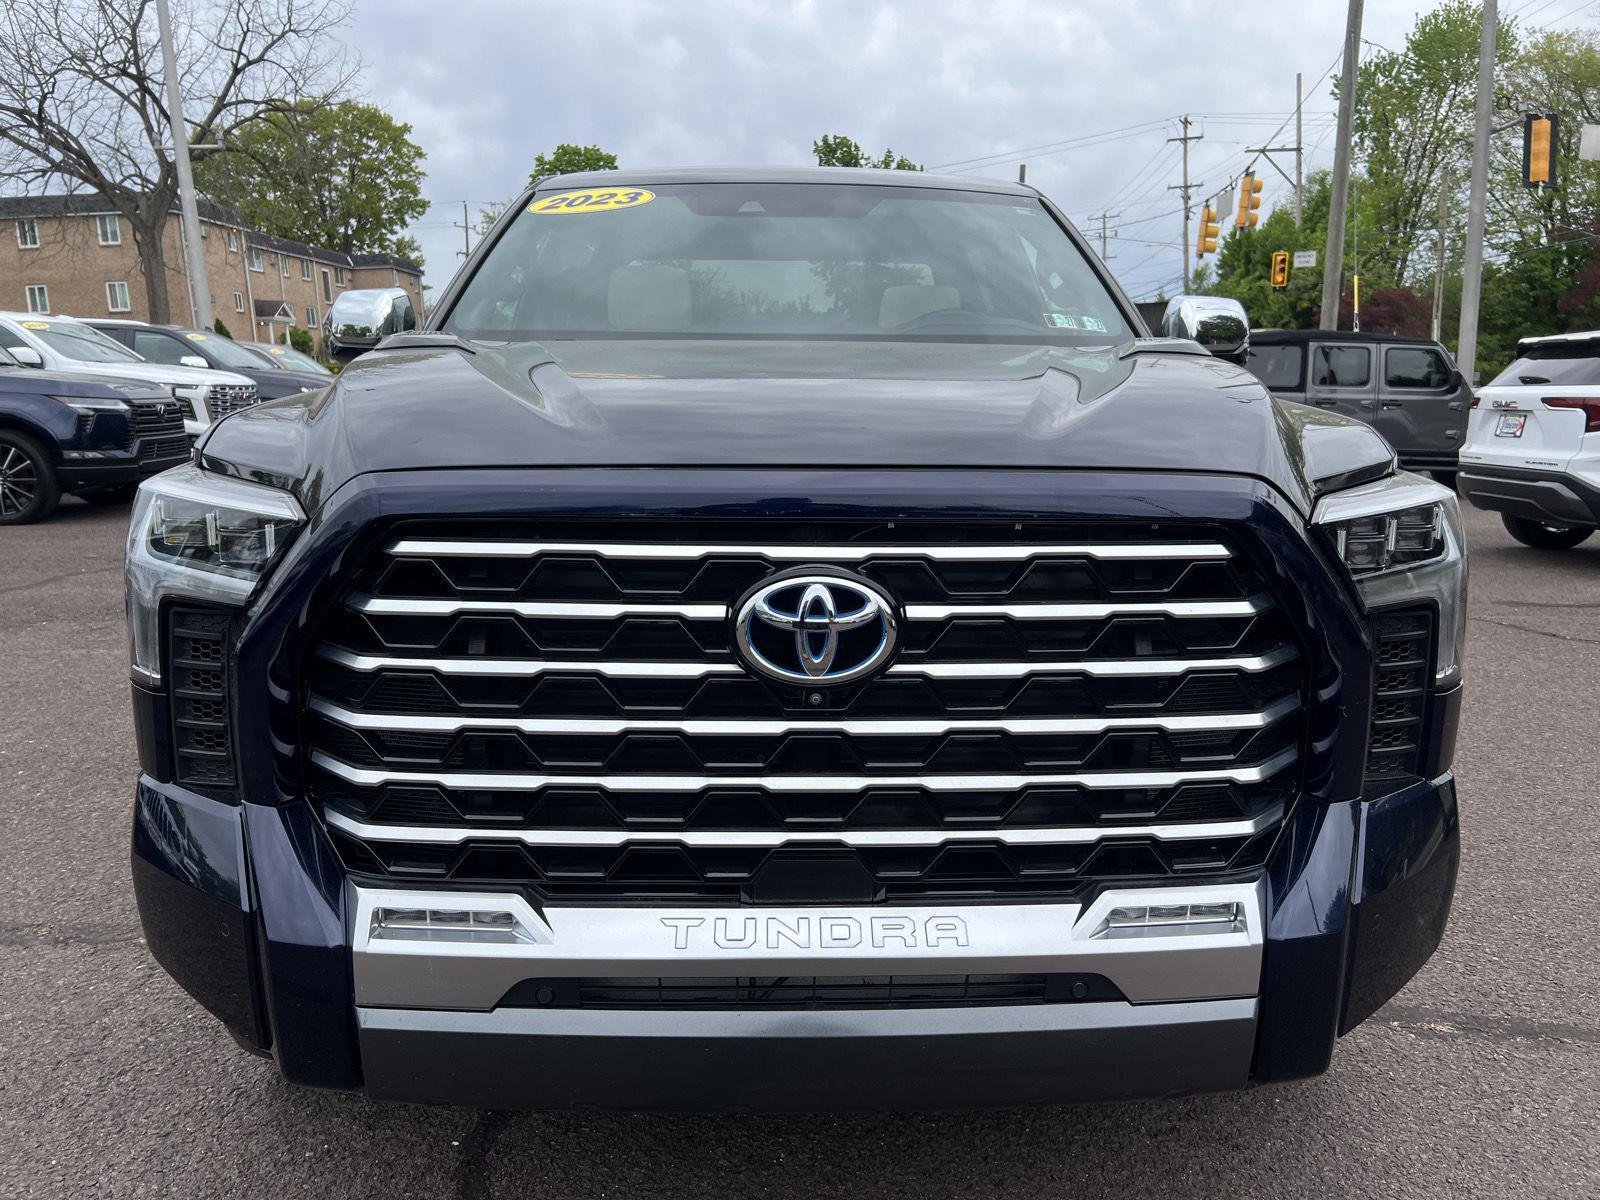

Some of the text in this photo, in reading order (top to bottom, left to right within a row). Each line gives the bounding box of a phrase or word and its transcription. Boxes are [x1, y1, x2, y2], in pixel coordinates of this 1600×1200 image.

[537, 192, 644, 211] 2023
[1492, 400, 1518, 408] GMC
[659, 915, 970, 950] TUNDRA
